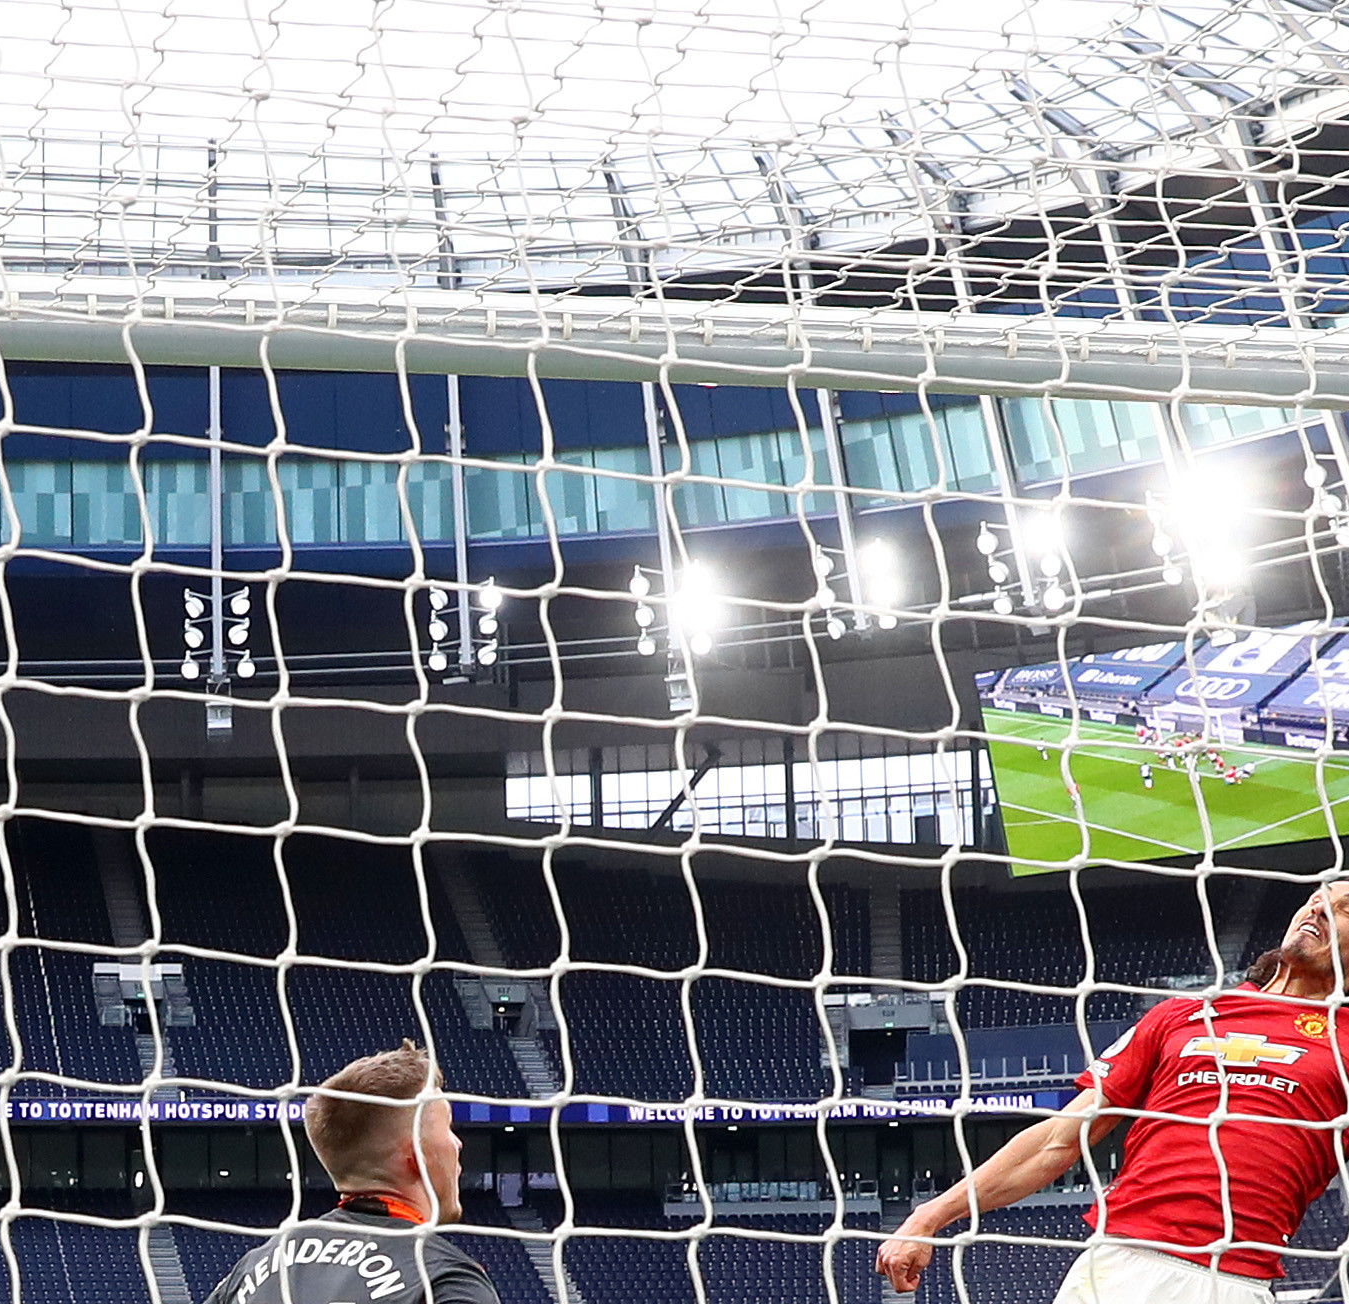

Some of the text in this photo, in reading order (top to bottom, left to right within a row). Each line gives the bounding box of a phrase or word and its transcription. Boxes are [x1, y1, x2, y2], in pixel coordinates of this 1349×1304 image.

[1177, 1069, 1300, 1094] CHEVROLET
[19, 1102, 42, 1119] TO
[48, 1102, 159, 1120] TOTTENHAM
[165, 1103, 249, 1121] HOTSPUR
[629, 1105, 720, 1121] WELCOME
[722, 1106, 744, 1120] TO
